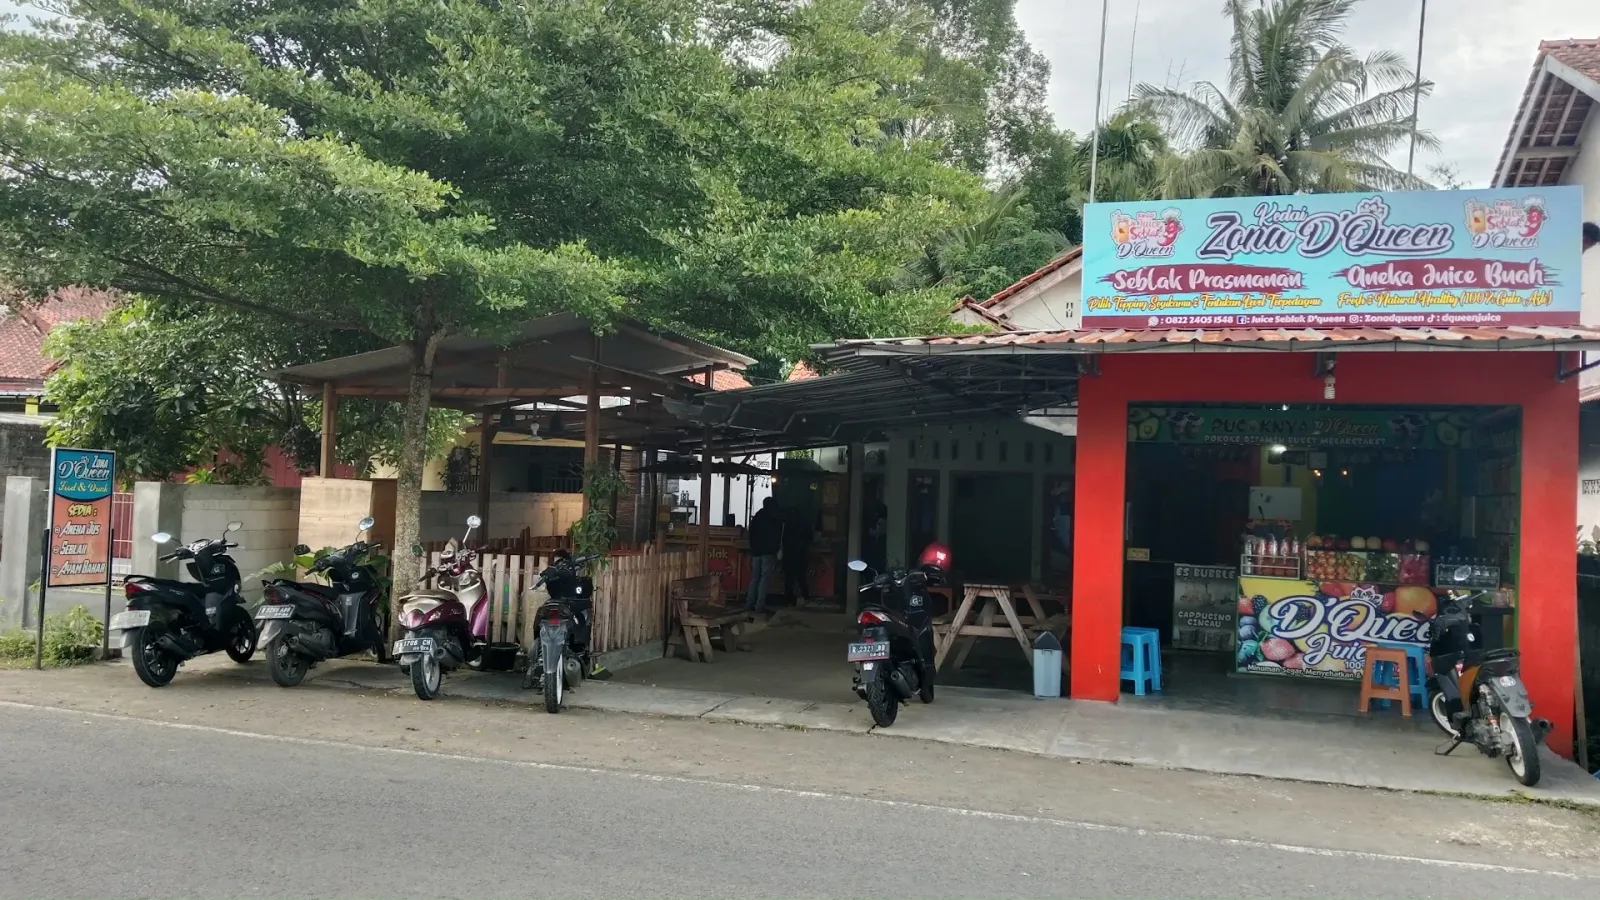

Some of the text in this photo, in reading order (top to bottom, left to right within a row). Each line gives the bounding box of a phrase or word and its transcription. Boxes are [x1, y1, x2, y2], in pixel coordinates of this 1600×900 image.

[1254, 202, 1308, 226] Kedai
[1197, 210, 1453, 260] Zona D'Queen
[1472, 231, 1537, 249] D'Queen
[1116, 241, 1174, 257] D'Queen
[1114, 268, 1303, 291] Seblak Prasmanan
[1422, 263, 1478, 287] Juice
[1484, 259, 1545, 287] Buah
[1087, 296, 1112, 312] Pilih
[1113, 296, 1147, 312] Topping
[1200, 293, 1241, 310] Tentukan
[1337, 291, 1365, 308] Fresh
[1374, 291, 1417, 308] Natural
[1417, 291, 1459, 308] Healthy
[1496, 291, 1522, 307] Gula
[1165, 316, 1187, 324] 0822
[1189, 316, 1213, 324] 2405
[1214, 316, 1233, 324] 1548
[1251, 315, 1274, 323] Juice
[1275, 315, 1306, 323] Seblak
[1307, 314, 1346, 325] D'queen
[1442, 313, 1501, 323] dqueenjuice
[58, 460, 110, 480] D'Queen
[59, 481, 77, 491] Food
[78, 482, 86, 491] &
[1176, 567, 1236, 580] ES BUBBLE
[1178, 611, 1231, 622] CAPPUCINO
[1187, 619, 1221, 628] CINCAU
[1303, 632, 1366, 665] Juic
[1247, 664, 1280, 674] Minuman
[1305, 669, 1354, 678] Menyehatkan
